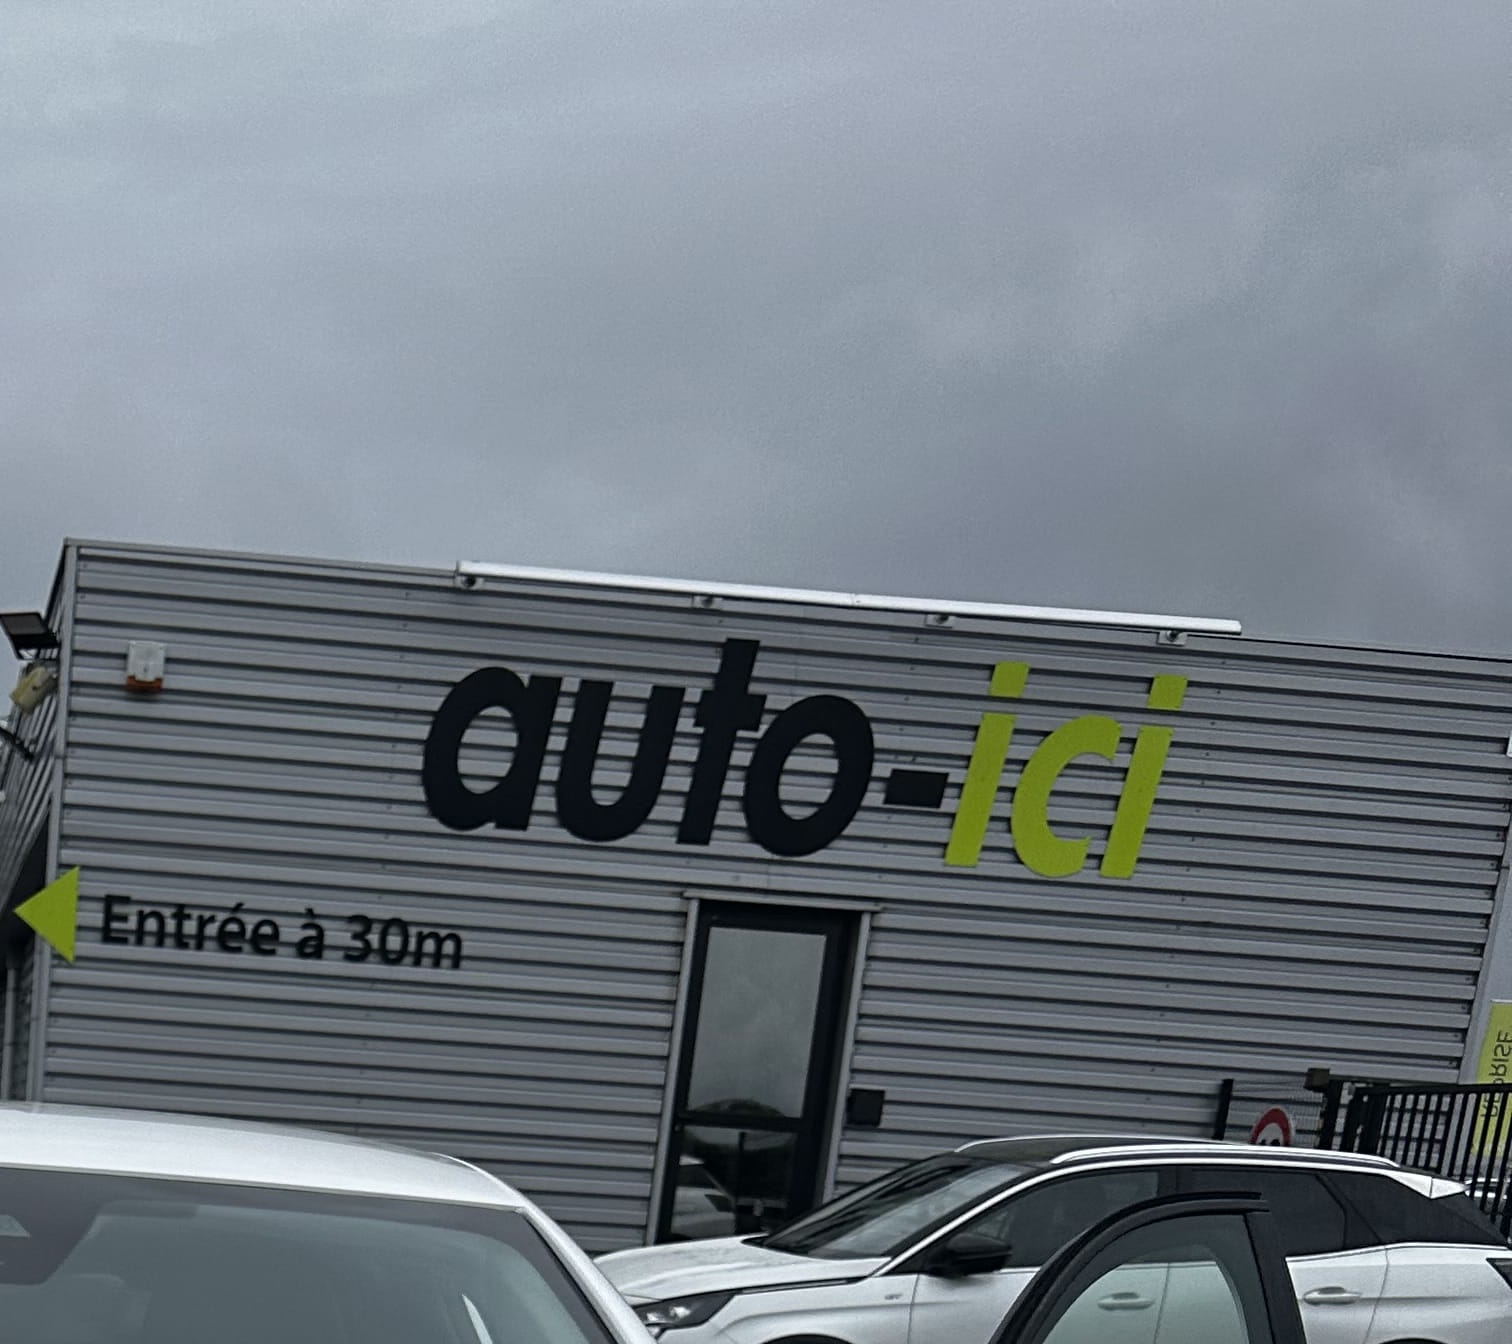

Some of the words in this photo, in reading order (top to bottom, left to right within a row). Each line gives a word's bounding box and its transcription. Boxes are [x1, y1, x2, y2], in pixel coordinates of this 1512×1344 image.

[100, 894, 280, 956] Entrée
[295, 906, 326, 961] à
[342, 912, 465, 970] 30m
